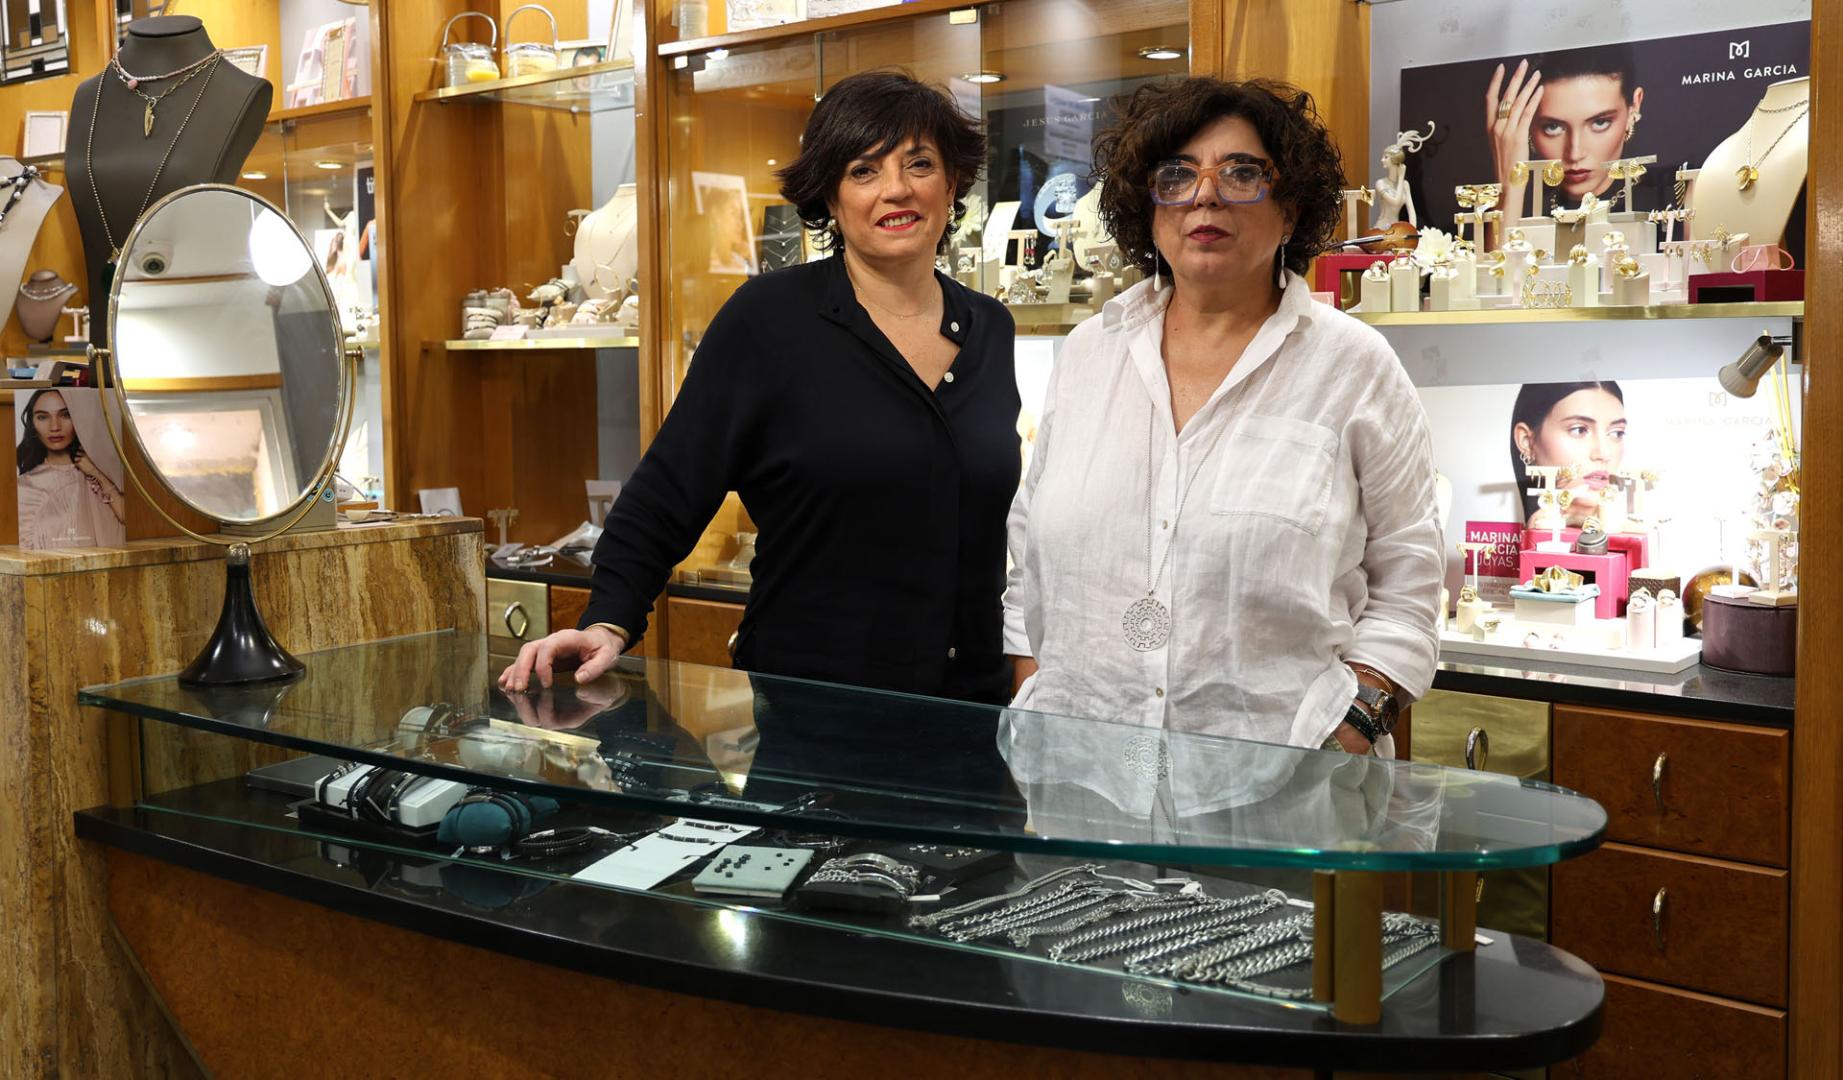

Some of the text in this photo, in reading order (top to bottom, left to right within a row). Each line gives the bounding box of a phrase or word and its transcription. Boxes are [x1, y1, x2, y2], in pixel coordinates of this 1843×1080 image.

[1681, 64, 1797, 86] MARINA GARCIA
[1470, 531, 1520, 543] MARINA
[1478, 554, 1514, 567] JOYAS
